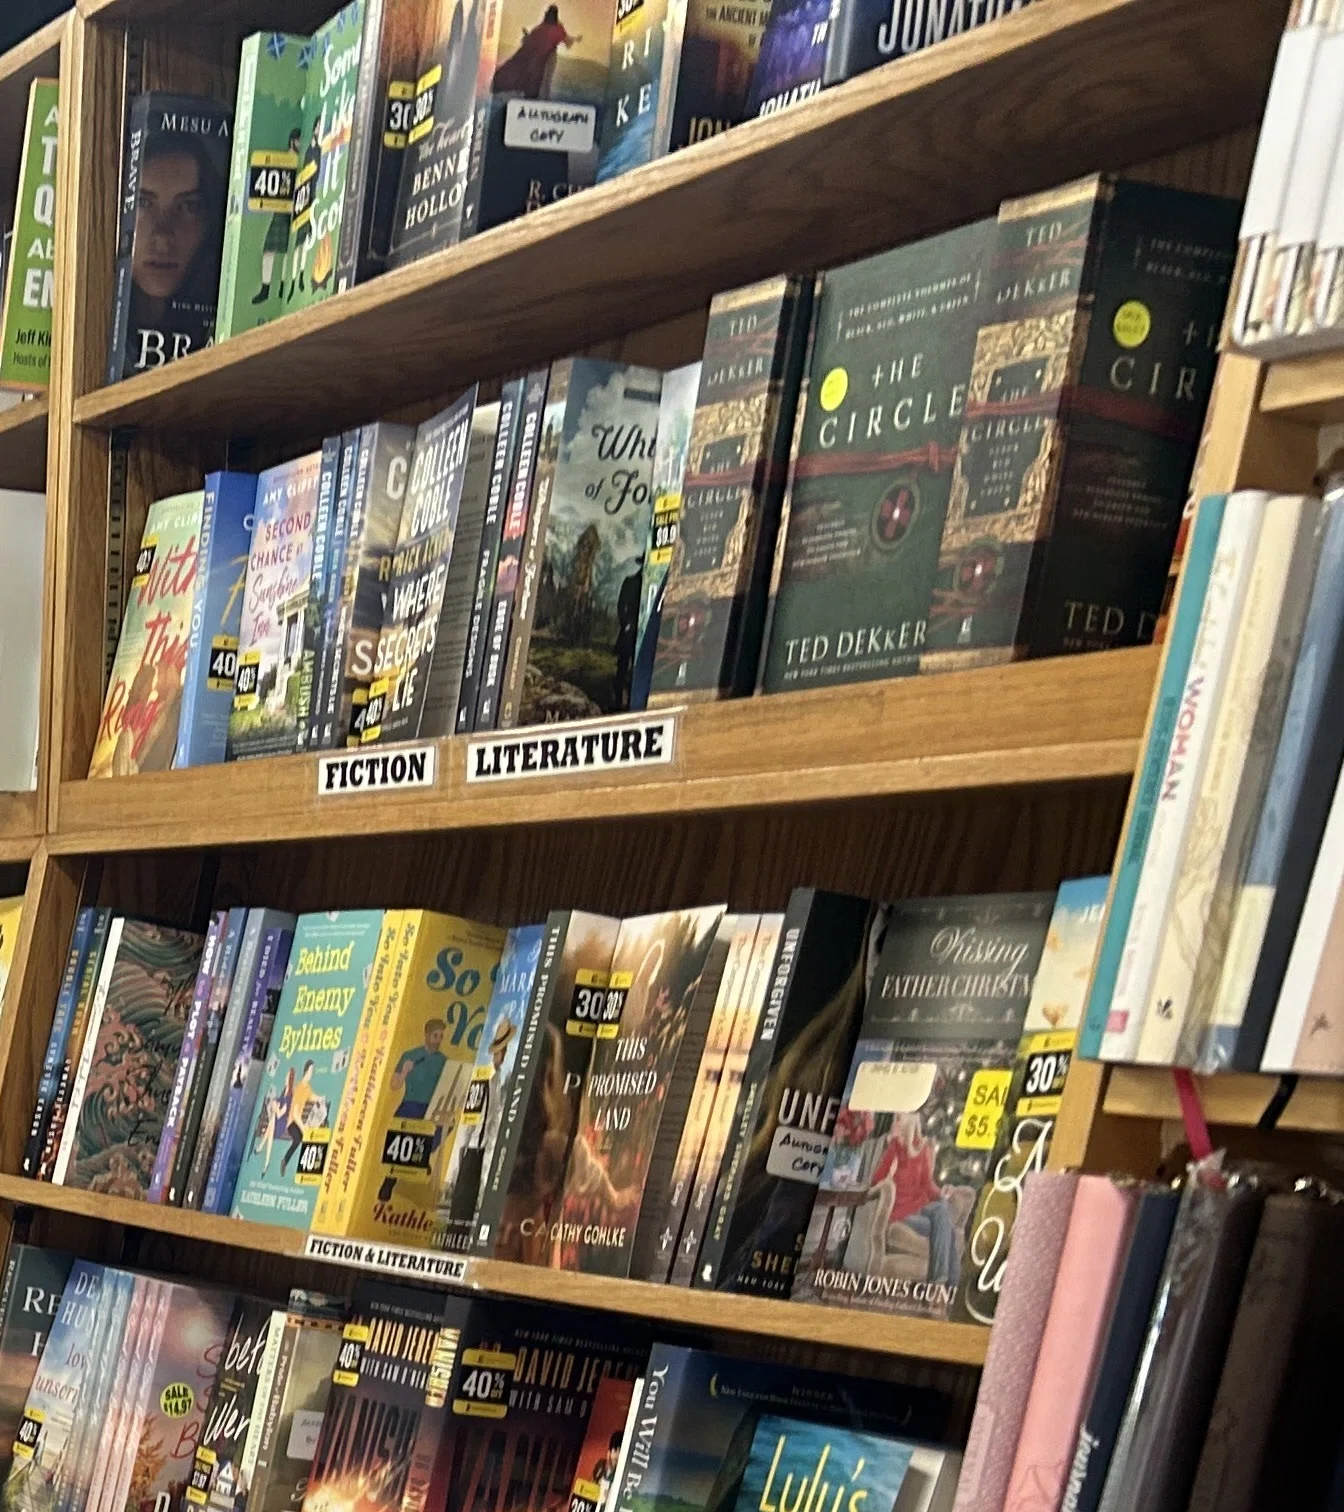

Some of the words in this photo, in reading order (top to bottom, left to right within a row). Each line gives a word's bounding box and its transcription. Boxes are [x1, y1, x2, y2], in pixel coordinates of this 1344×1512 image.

[162, 112, 211, 133] MESU
[1024, 221, 1063, 245] TED
[15, 328, 36, 348] Jeff
[265, 513, 312, 542] SECOND
[391, 566, 446, 622] WHERE
[373, 616, 440, 672] SECRETS
[475, 724, 663, 778] LITERATURE
[325, 752, 426, 789] FICTION
[295, 941, 353, 978] Behind
[542, 926, 560, 972] THIS
[426, 947, 481, 996] So
[759, 928, 800, 1042] UNFORGIVEN
[292, 984, 356, 1018] Enemy
[278, 1021, 344, 1055] Bylines
[521, 974, 549, 1070] PROMISED
[614, 1037, 647, 1063] THIS
[507, 1072, 527, 1123] LAND
[588, 1070, 657, 1098] PROMISED
[594, 1108, 632, 1131] LAND
[550, 1223, 582, 1242] CATHY
[584, 1225, 626, 1248] GOHLKE
[310, 1239, 364, 1262] FICTION
[364, 1247, 374, 1262] &
[376, 1248, 464, 1278] LITERATURE
